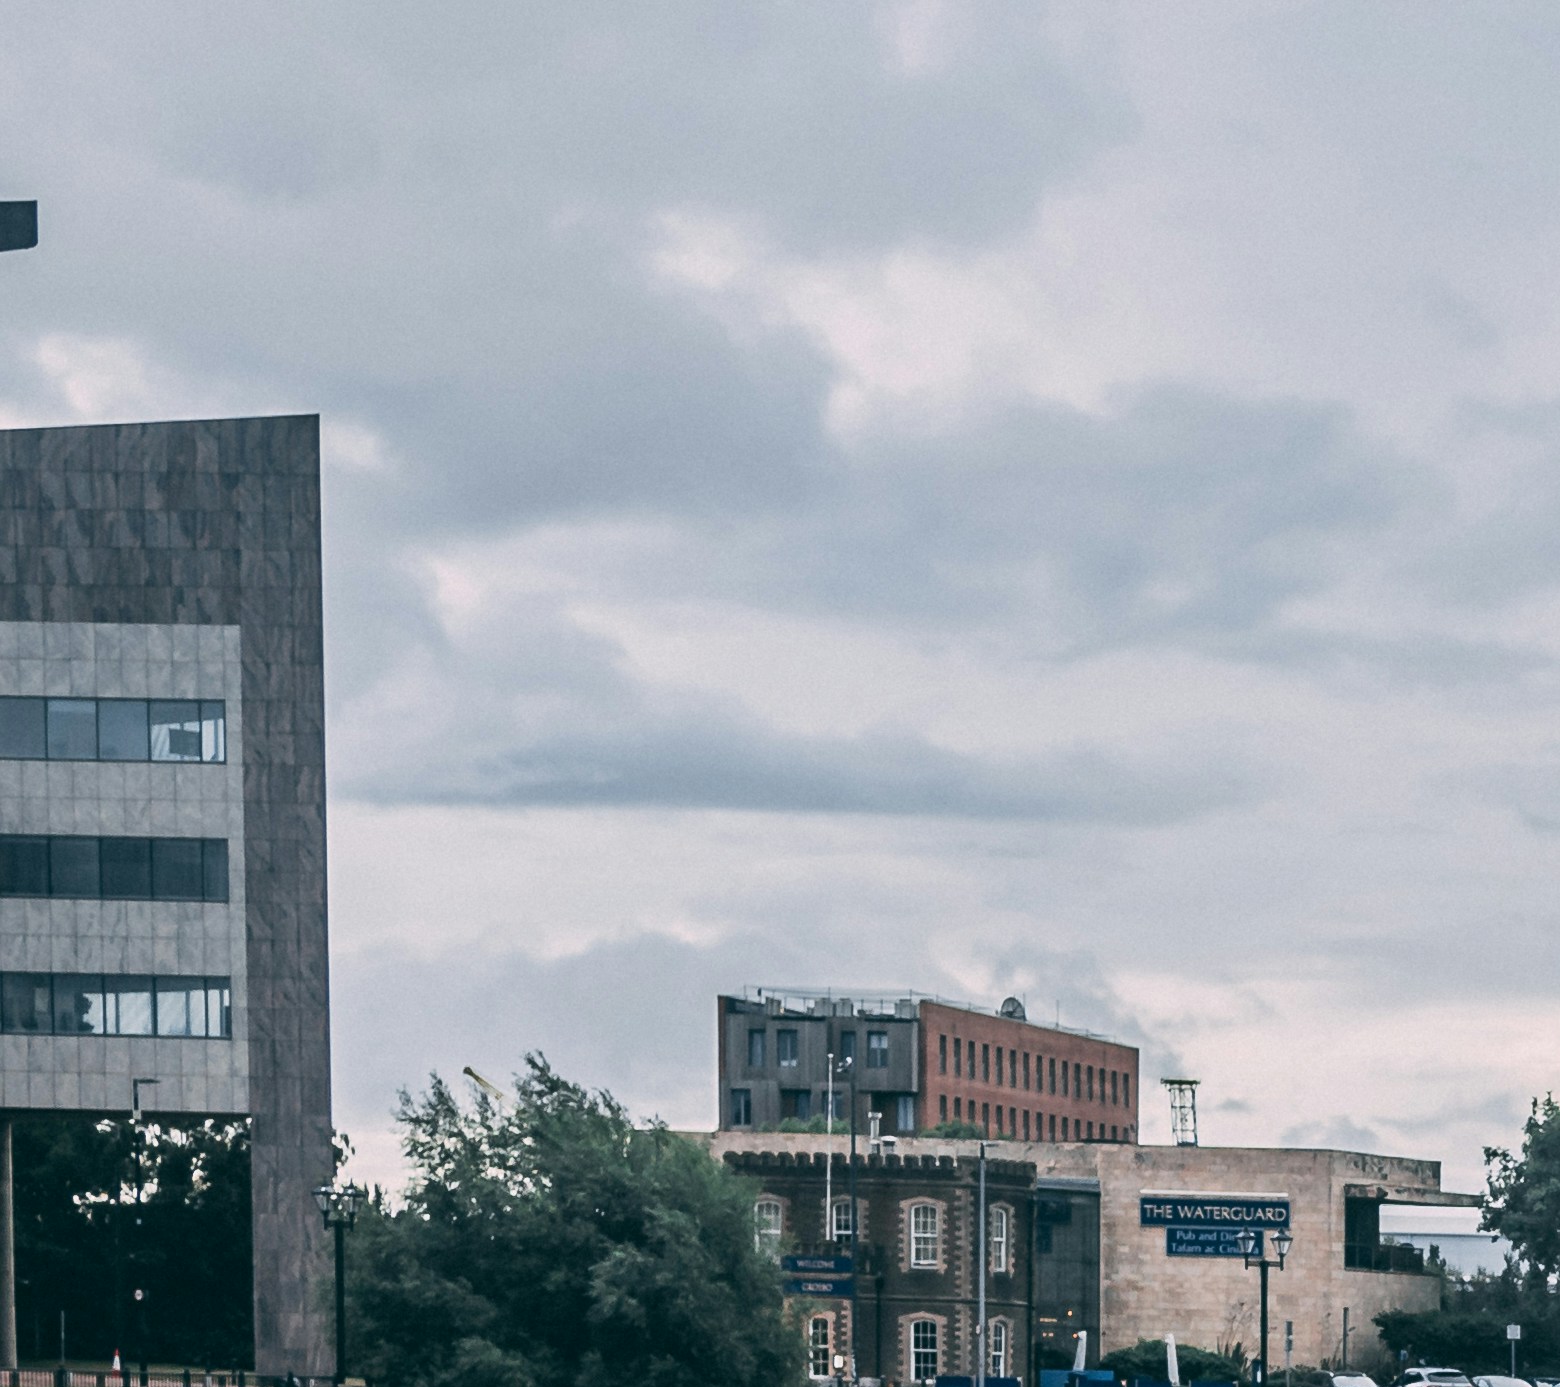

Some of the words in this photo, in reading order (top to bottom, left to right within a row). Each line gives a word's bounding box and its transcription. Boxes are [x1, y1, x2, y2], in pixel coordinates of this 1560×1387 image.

[1144, 1204, 1173, 1219] THE
[1177, 1205, 1287, 1222] WATERGUARD
[1176, 1230, 1196, 1241] Pub
[1198, 1231, 1217, 1241] and
